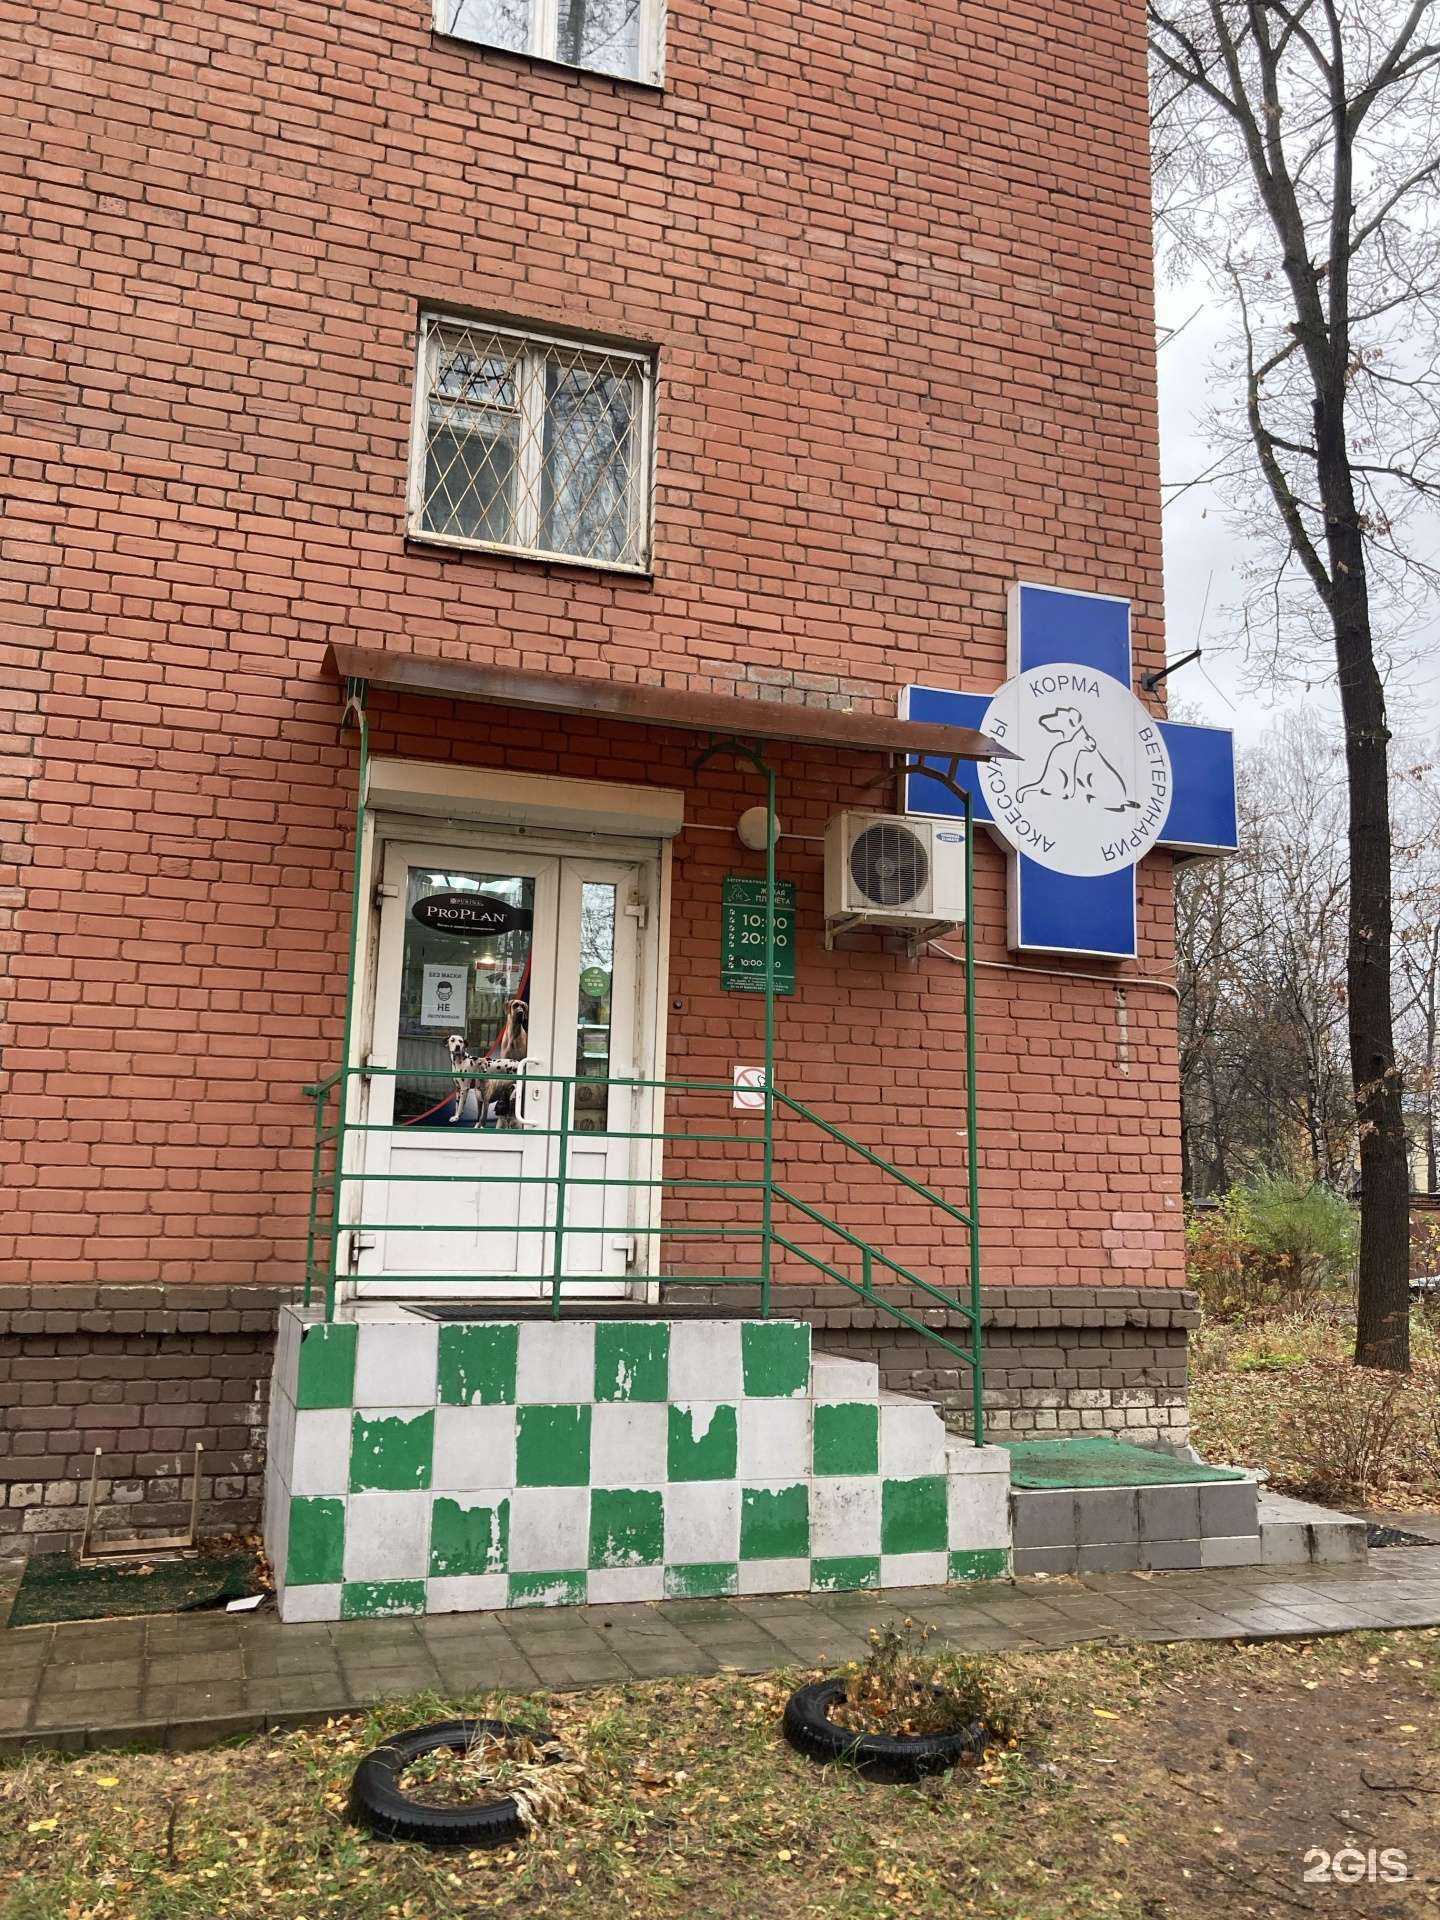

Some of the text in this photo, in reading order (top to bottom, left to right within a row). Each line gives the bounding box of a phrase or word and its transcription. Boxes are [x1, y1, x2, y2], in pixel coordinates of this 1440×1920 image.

[1029, 675, 1101, 698] КОРМА
[987, 718, 1056, 853] АКСЕССУАЫ
[1101, 727, 1166, 862] ВЕТЕРИНАРИЯ
[755, 895, 791, 905] ПЛЕТА
[761, 888, 786, 896] ЖАЯ
[437, 1003, 451, 1012] НЕ
